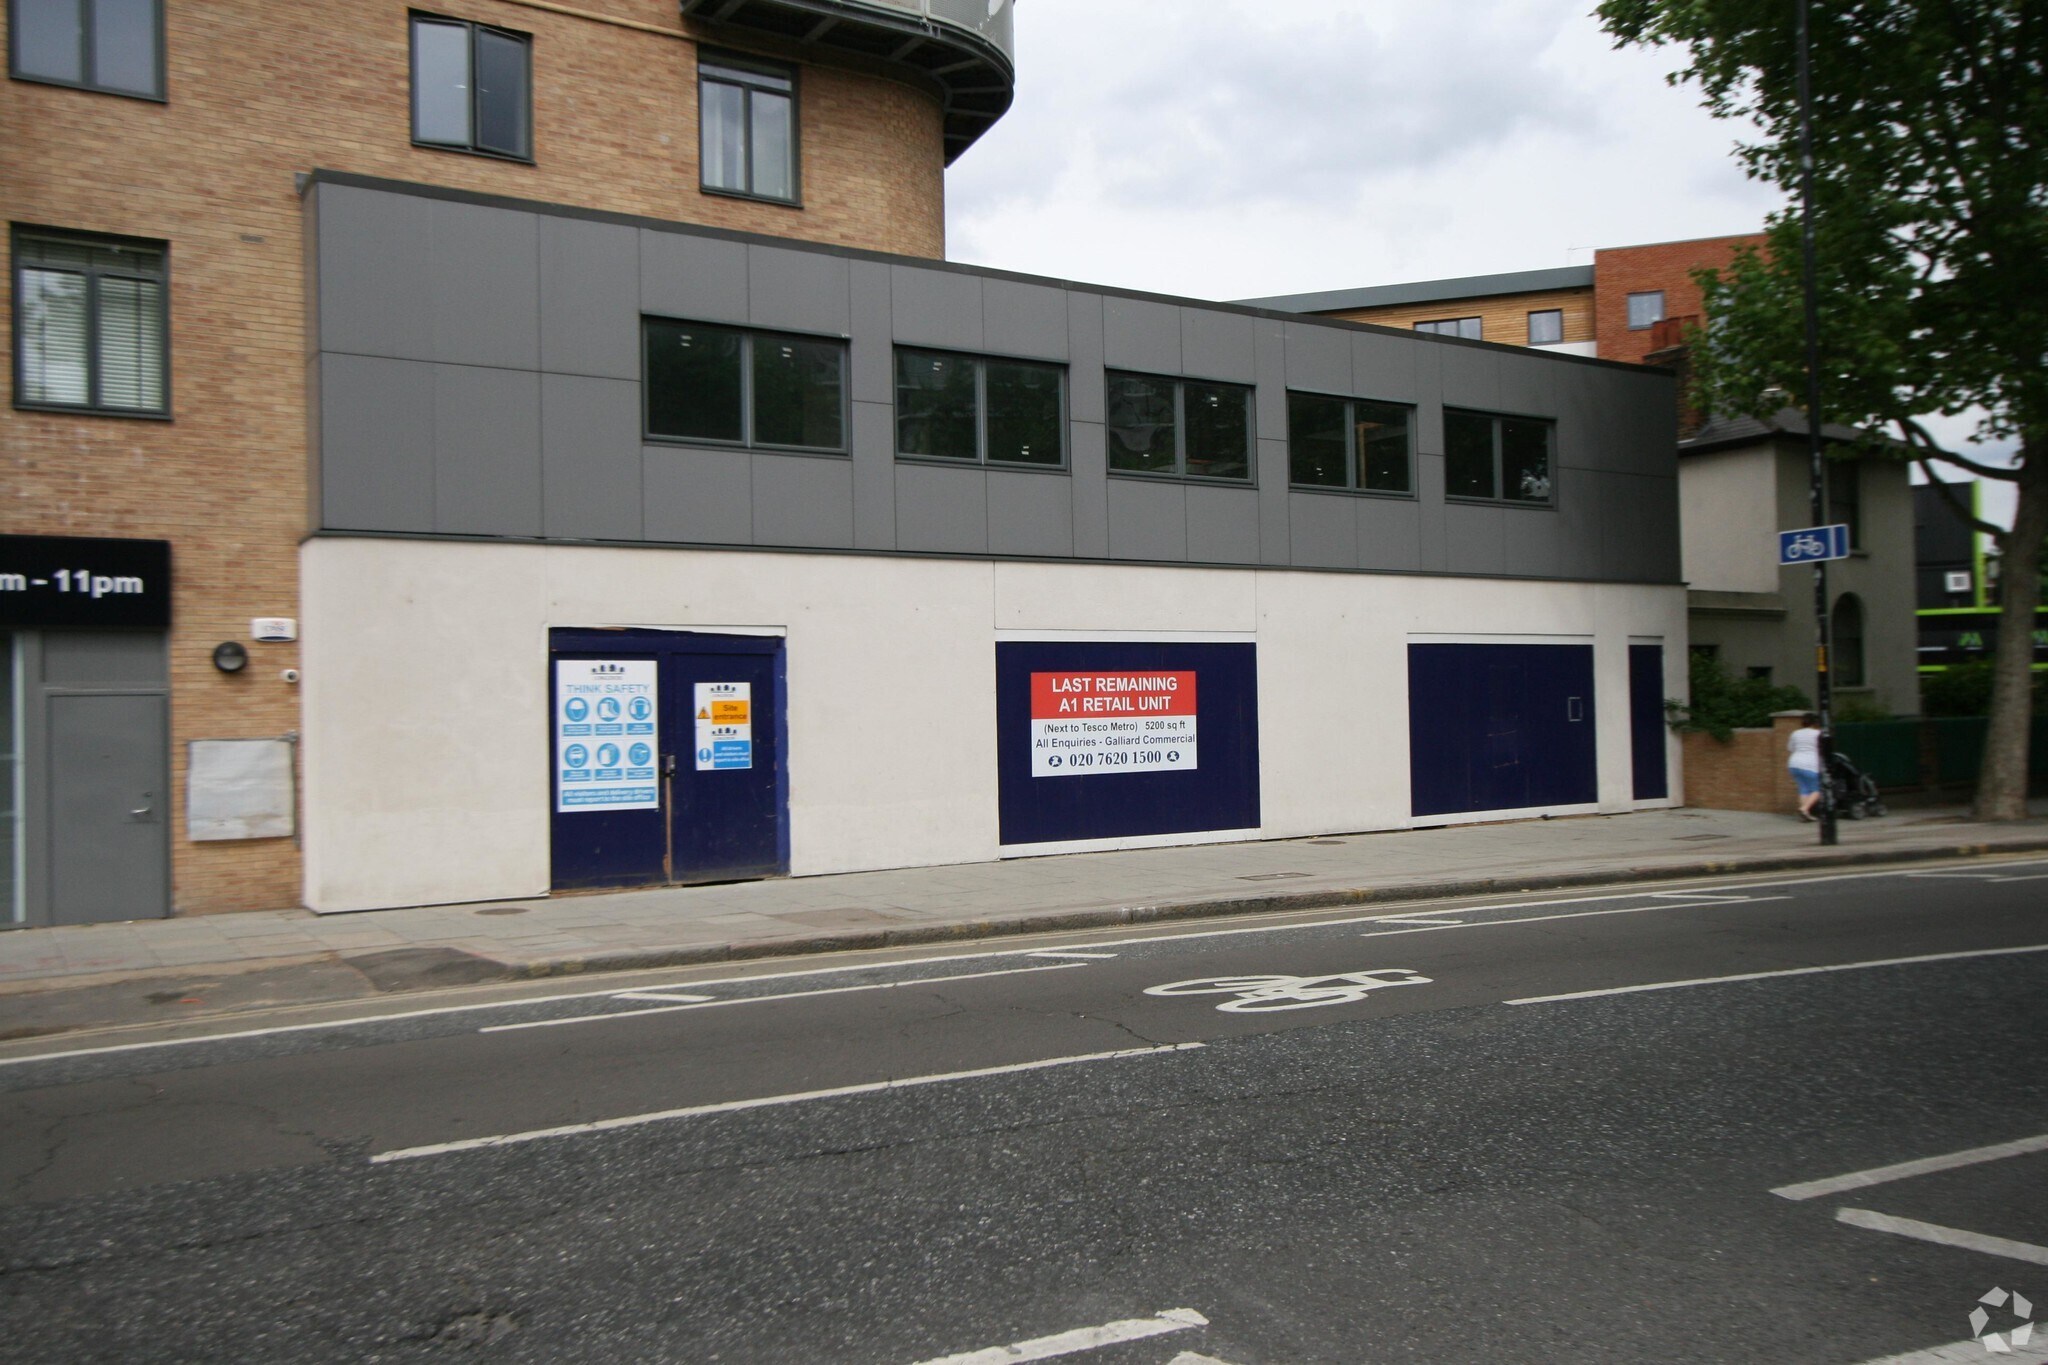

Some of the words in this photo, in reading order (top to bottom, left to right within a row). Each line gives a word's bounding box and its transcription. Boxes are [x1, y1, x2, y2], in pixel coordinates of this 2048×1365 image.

[52, 569, 144, 598] 11pm
[566, 684, 601, 693] THINK
[605, 684, 650, 693] SAFETY
[1052, 678, 1091, 692] LAST
[1096, 677, 1177, 692] REMAINING
[1059, 698, 1077, 712] A1
[1083, 697, 1134, 711] RETAIL
[1138, 696, 1171, 710] UNIT
[1044, 723, 1068, 735] (Next
[1070, 724, 1079, 732] to
[1082, 722, 1108, 732] Tesco
[1110, 721, 1138, 733] Metro)
[1145, 720, 1165, 730] 5200
[1167, 722, 1178, 731] sq
[1179, 720, 1186, 729] ft
[1036, 738, 1049, 748] All
[1051, 737, 1096, 749] Enquiries
[1105, 735, 1140, 746] Galliard
[1142, 733, 1195, 744] Commercial
[1069, 753, 1093, 767] 020
[1097, 751, 1128, 765] 7620
[1132, 750, 1162, 764] 1500
